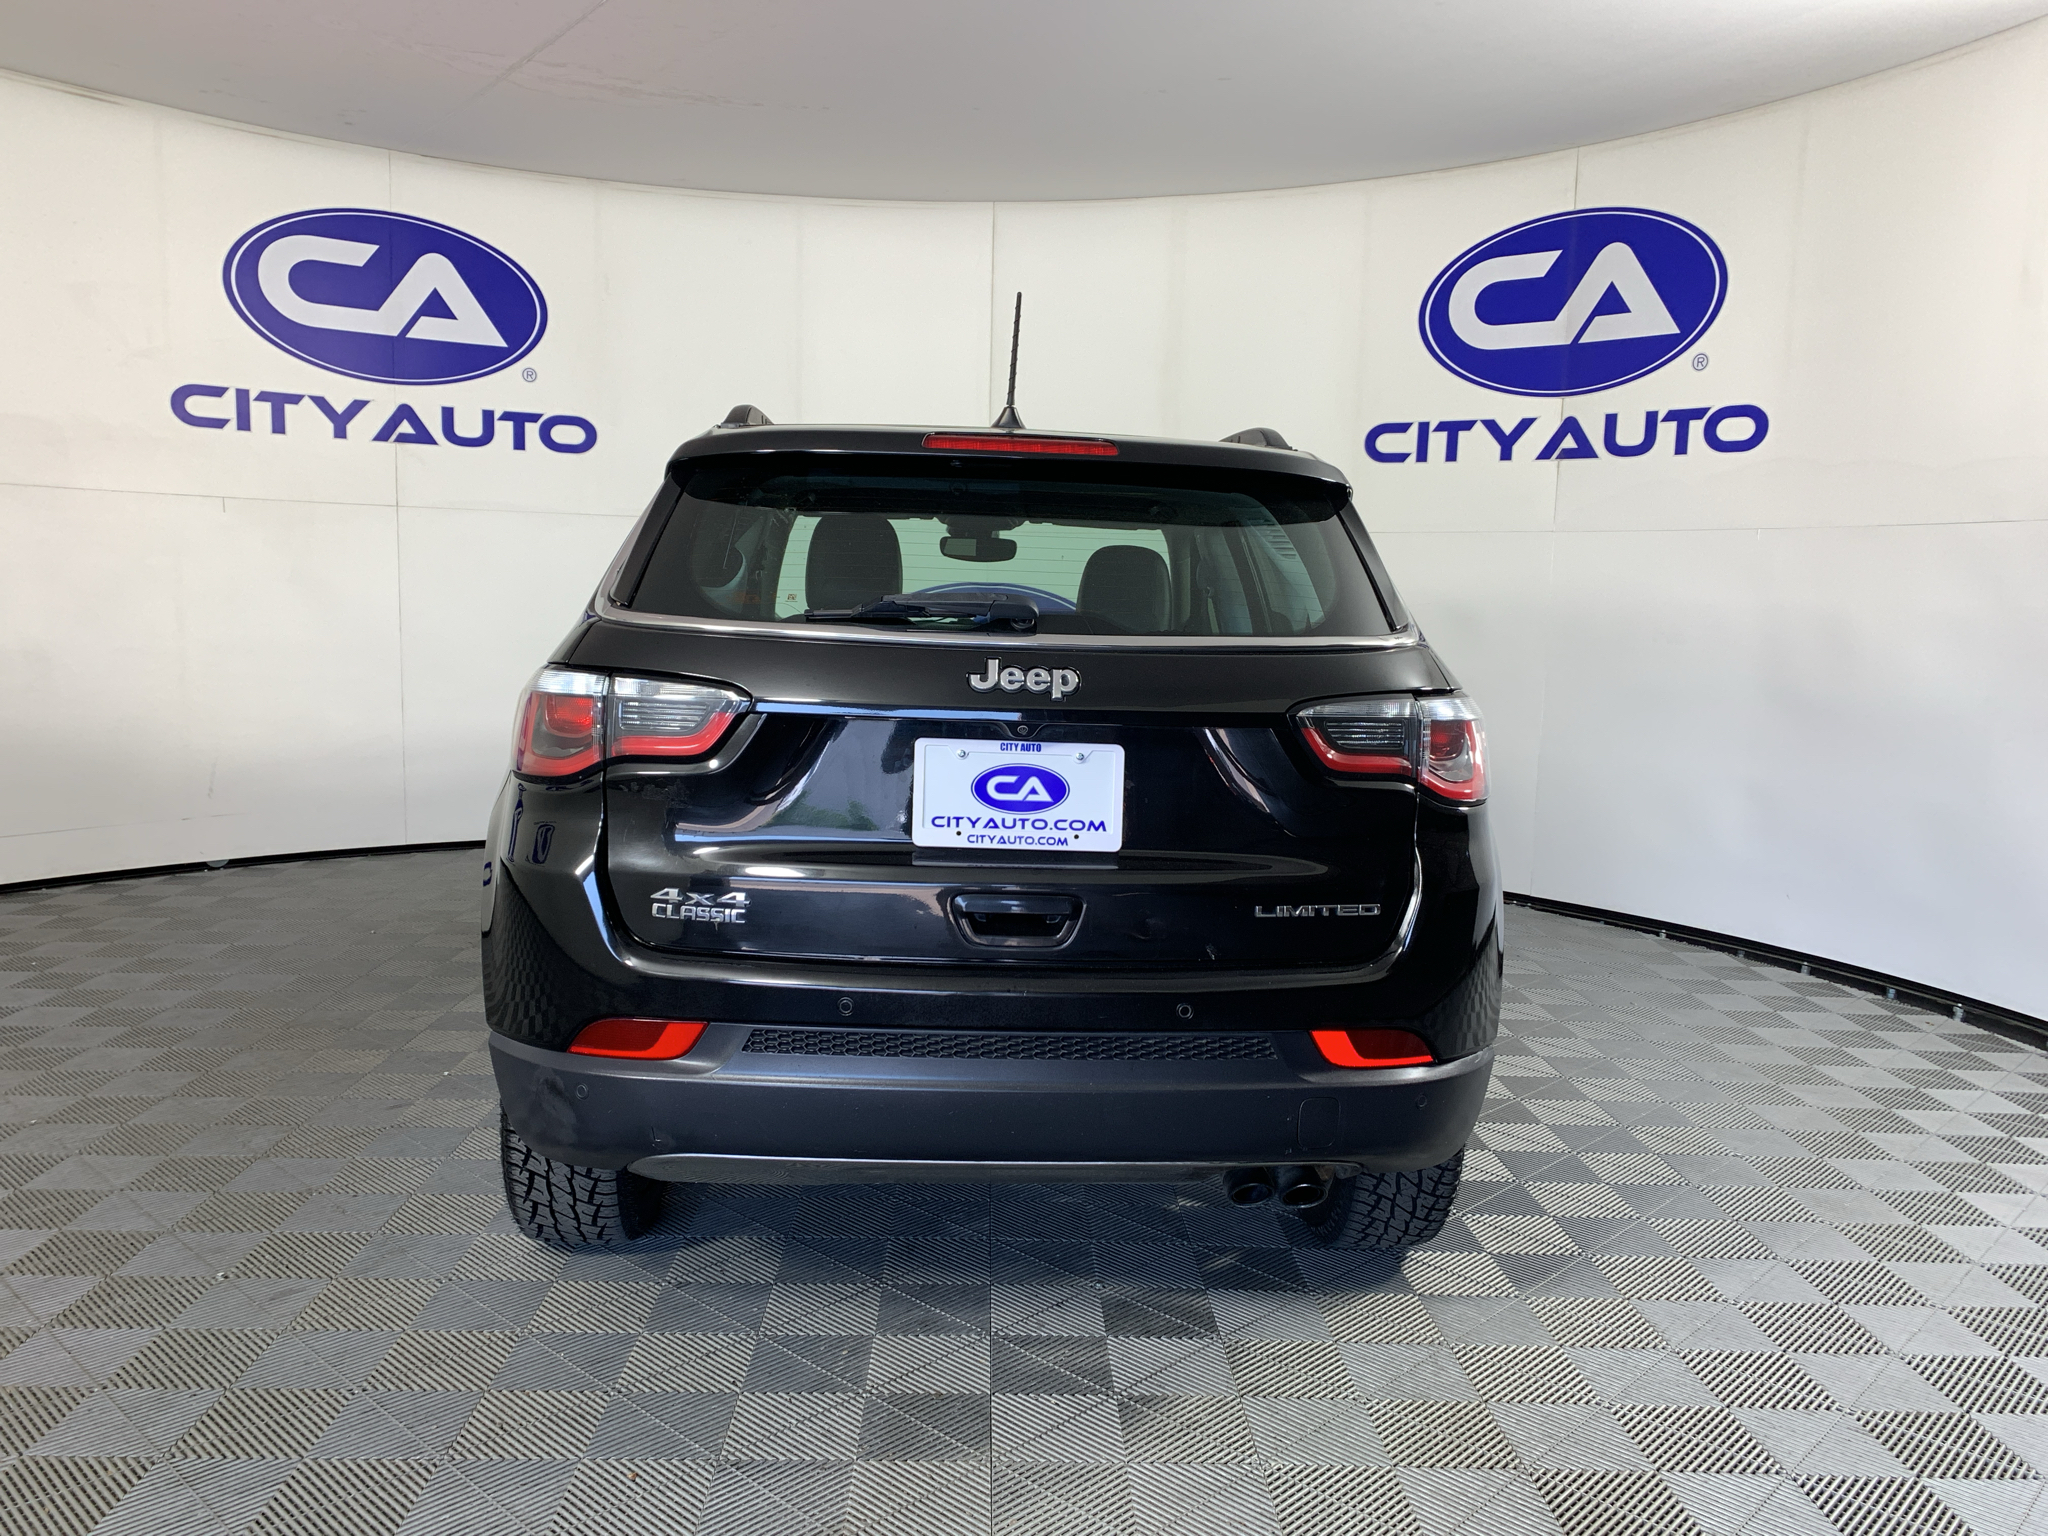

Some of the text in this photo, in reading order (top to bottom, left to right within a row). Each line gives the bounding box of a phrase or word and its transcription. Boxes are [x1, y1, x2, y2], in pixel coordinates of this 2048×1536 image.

[258, 234, 508, 348] CA
[1448, 241, 1681, 350] CA
[969, 657, 1081, 700] Jeep
[1000, 742, 1042, 752] CITY AUTO
[986, 775, 1054, 803] CA
[651, 902, 746, 924] CLASSIC
[1254, 904, 1381, 917] LIMITED
